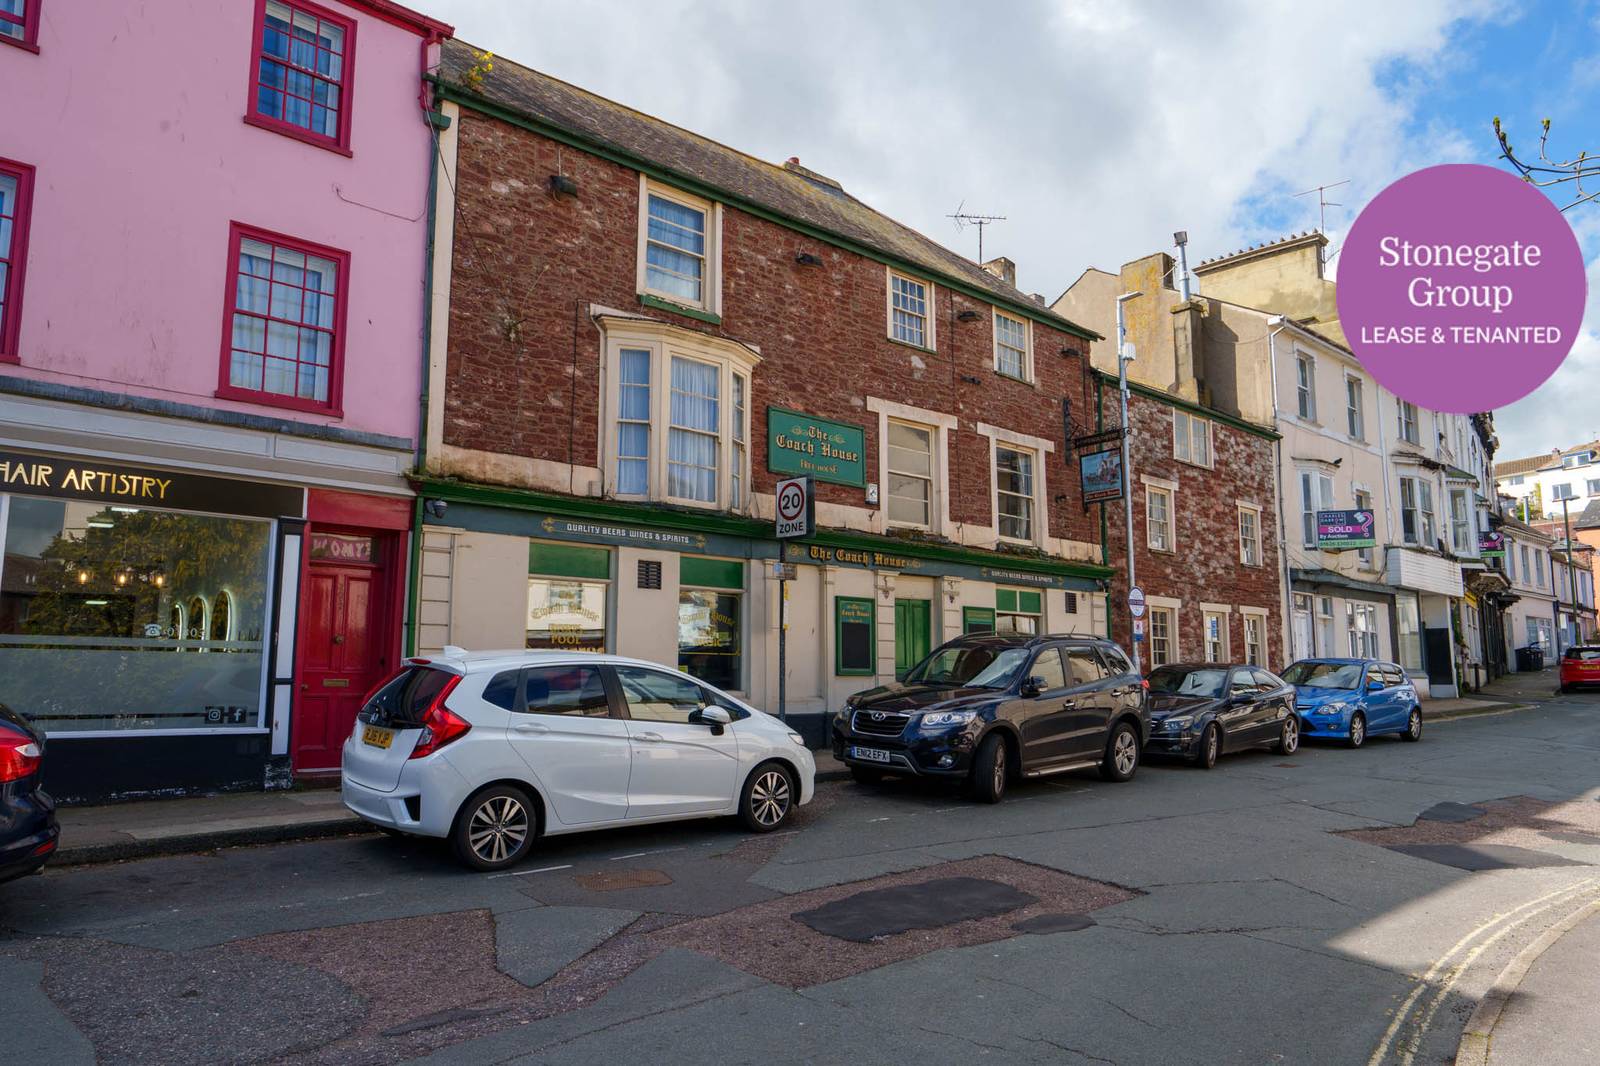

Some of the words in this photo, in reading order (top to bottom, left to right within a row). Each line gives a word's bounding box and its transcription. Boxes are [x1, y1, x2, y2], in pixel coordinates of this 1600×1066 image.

[808, 426, 828, 442] The
[776, 434, 814, 456] Coach
[821, 442, 858, 462] House
[61, 468, 172, 499] ARTISTRY
[782, 493, 801, 510] 20
[566, 523, 600, 534] QUALITY
[602, 527, 626, 537] BEERS
[629, 530, 653, 540] WINES
[655, 532, 661, 541] &
[662, 533, 690, 544] SPIRITS
[779, 521, 804, 533] ZONE
[810, 545, 832, 560] The
[836, 548, 869, 566] Coach
[874, 552, 906, 568] House
[856, 747, 872, 759] EN12
[873, 749, 887, 761] EFX
